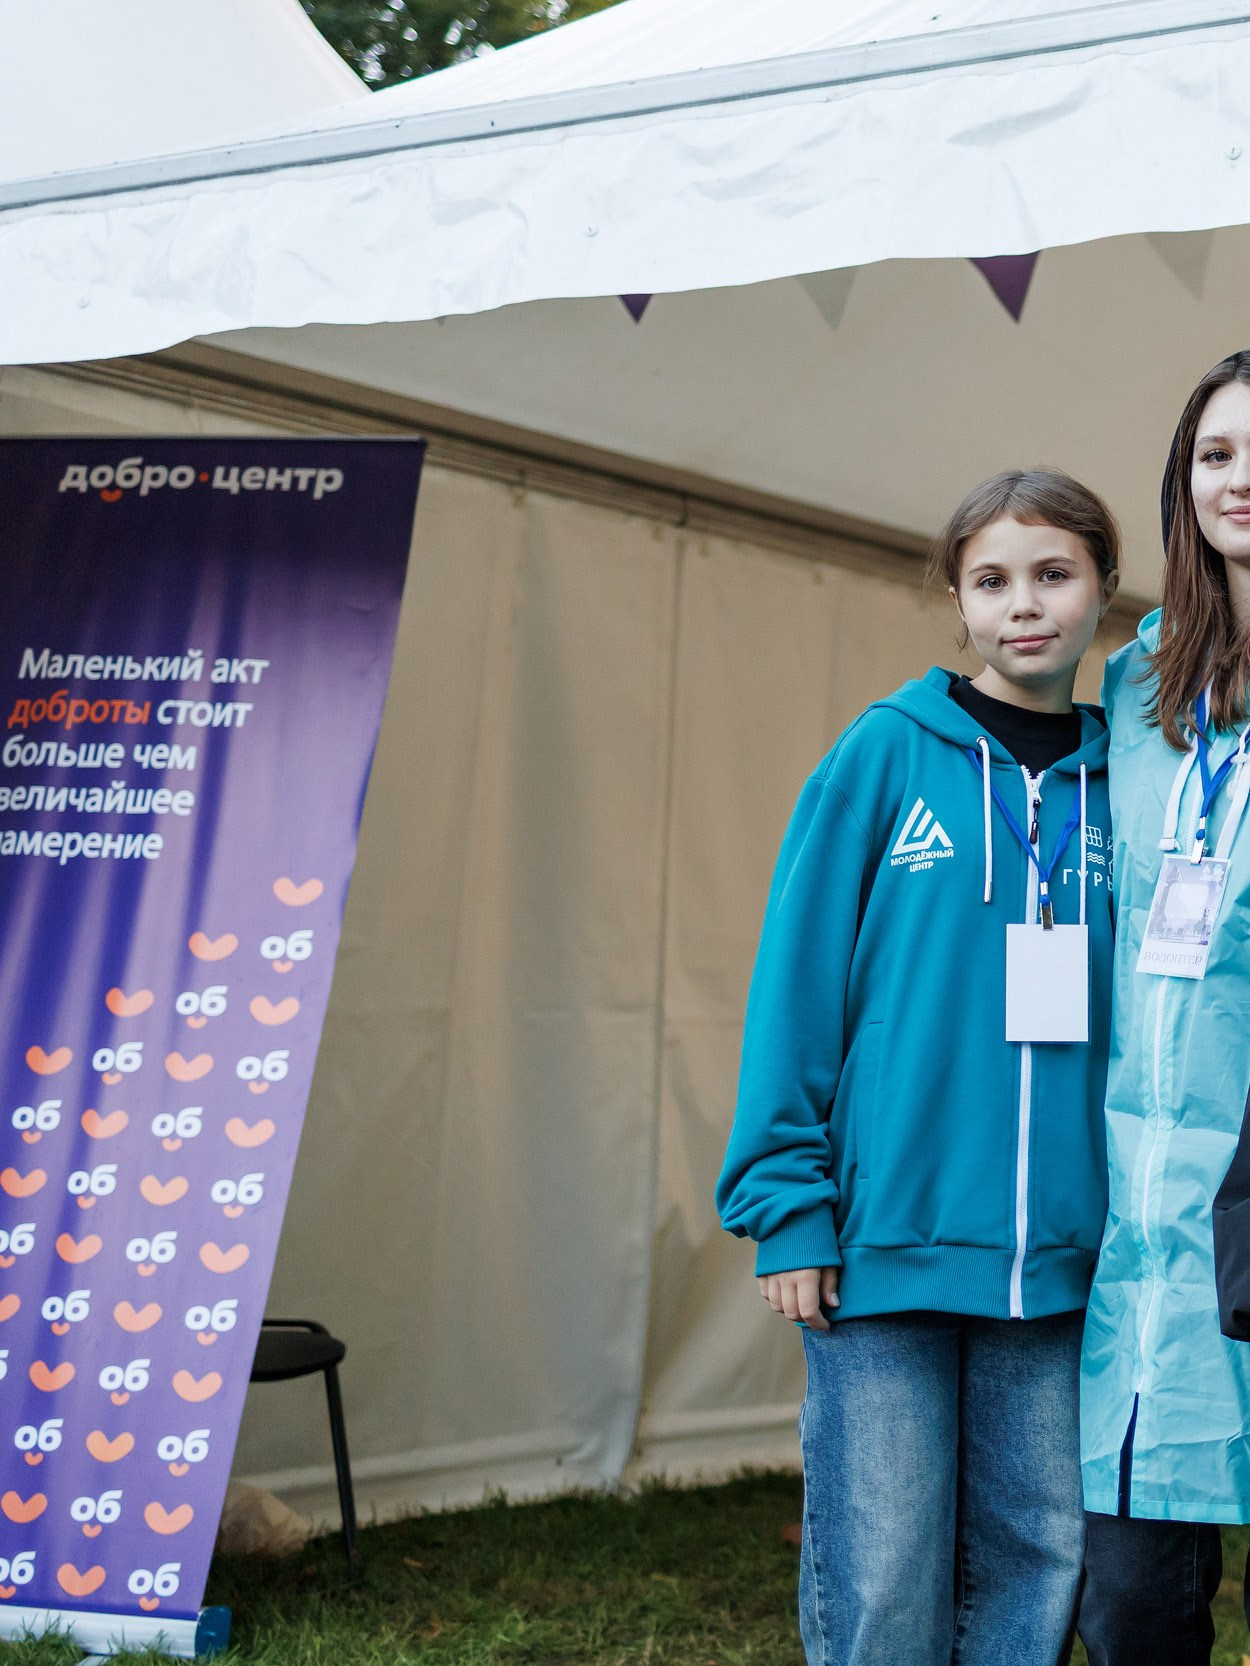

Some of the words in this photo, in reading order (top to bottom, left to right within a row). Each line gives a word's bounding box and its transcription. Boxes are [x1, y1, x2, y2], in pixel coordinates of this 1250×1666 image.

[18, 648, 204, 682] Маленький
[211, 658, 270, 684] акт
[7, 689, 151, 730] доброты
[156, 699, 254, 728] стоит
[2, 734, 125, 769] больше
[133, 743, 198, 772] чем
[0, 780, 196, 816] величайшее
[0, 830, 165, 866] амерение
[909, 861, 934, 873] ЦЕНТР
[260, 929, 314, 961] об
[176, 985, 228, 1017] об
[92, 1041, 143, 1073] об
[236, 1049, 290, 1081] об
[11, 1099, 62, 1131] об
[151, 1106, 203, 1138] об
[67, 1163, 118, 1196] об
[211, 1172, 265, 1205] об
[125, 1230, 178, 1263] об
[41, 1289, 91, 1322] об
[184, 1299, 238, 1332] об
[99, 1358, 151, 1392] об
[14, 1418, 63, 1451] об
[157, 1429, 210, 1462] об
[70, 1490, 122, 1523] об
[128, 1562, 181, 1596] об
